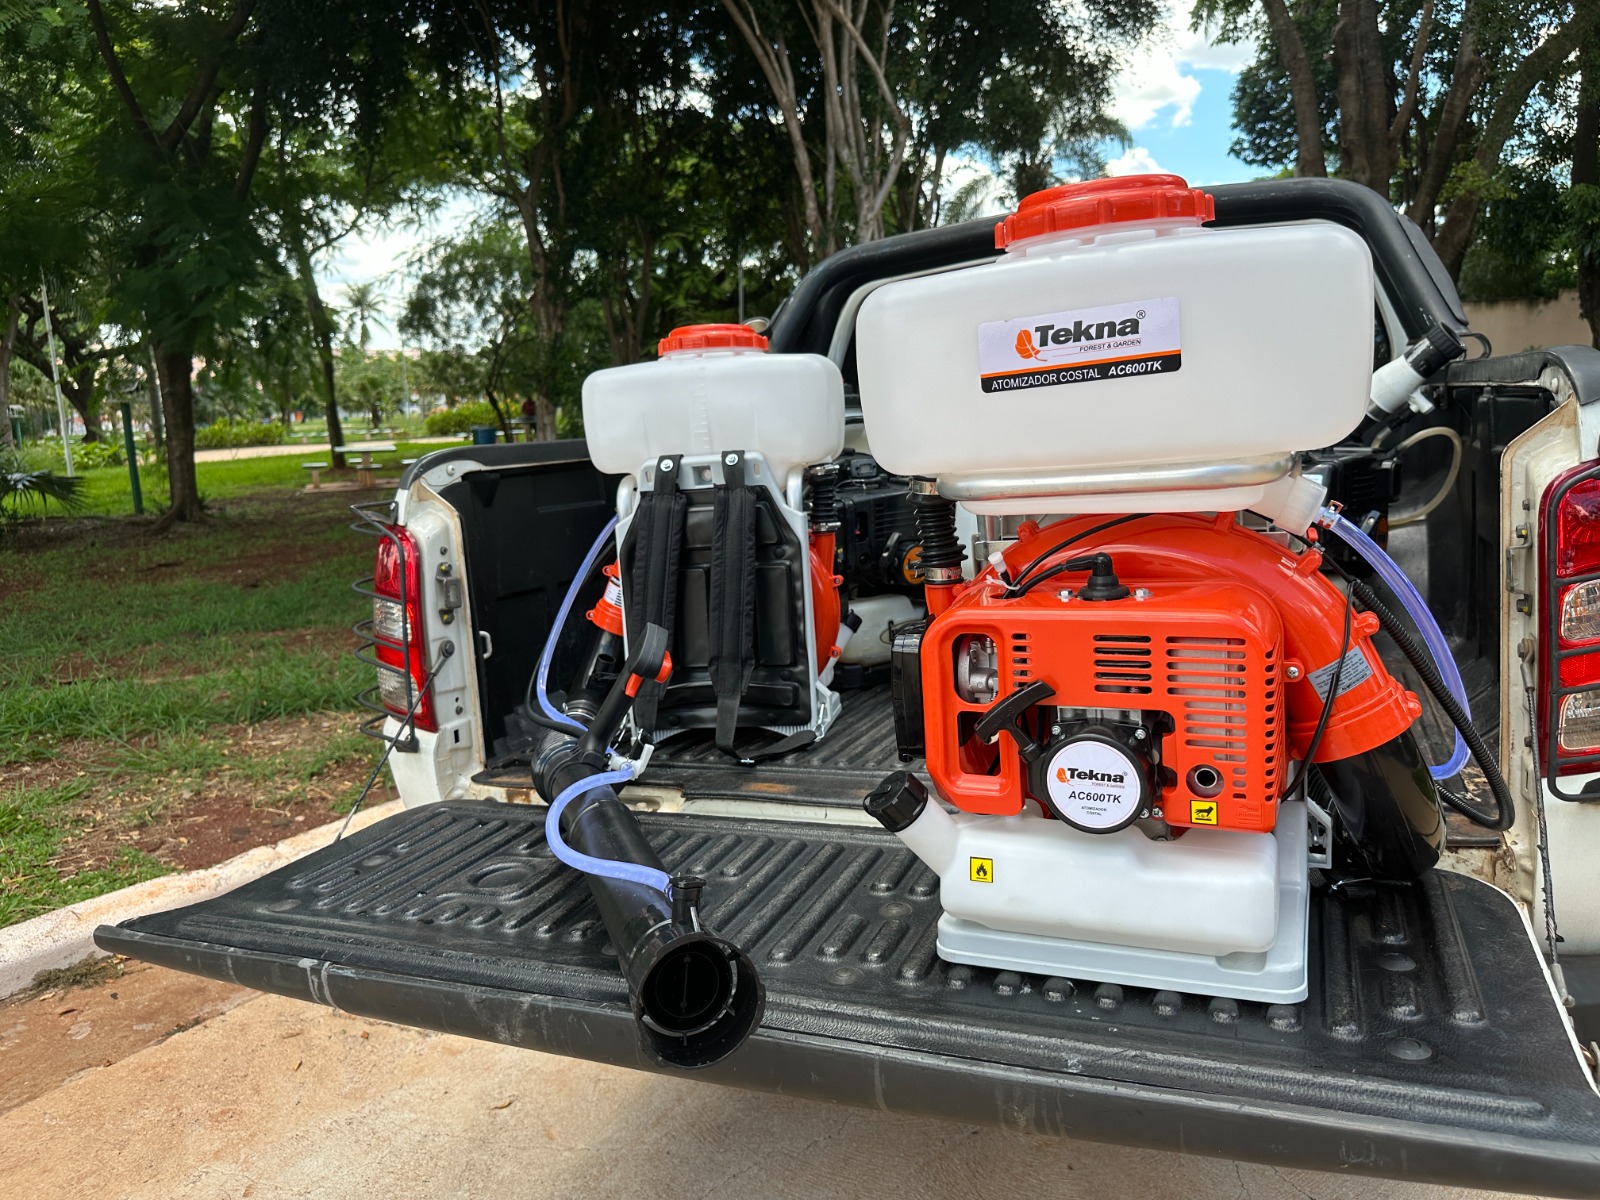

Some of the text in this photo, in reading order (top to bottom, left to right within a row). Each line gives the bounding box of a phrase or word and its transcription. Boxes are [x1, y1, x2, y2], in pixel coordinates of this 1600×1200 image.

[1079, 343, 1105, 353] FOREST
[1112, 338, 1142, 348] GARDEN
[991, 360, 1162, 391] ATOMIZADOR COSTAL AC600TK
[1068, 791, 1121, 803] AC600TK
